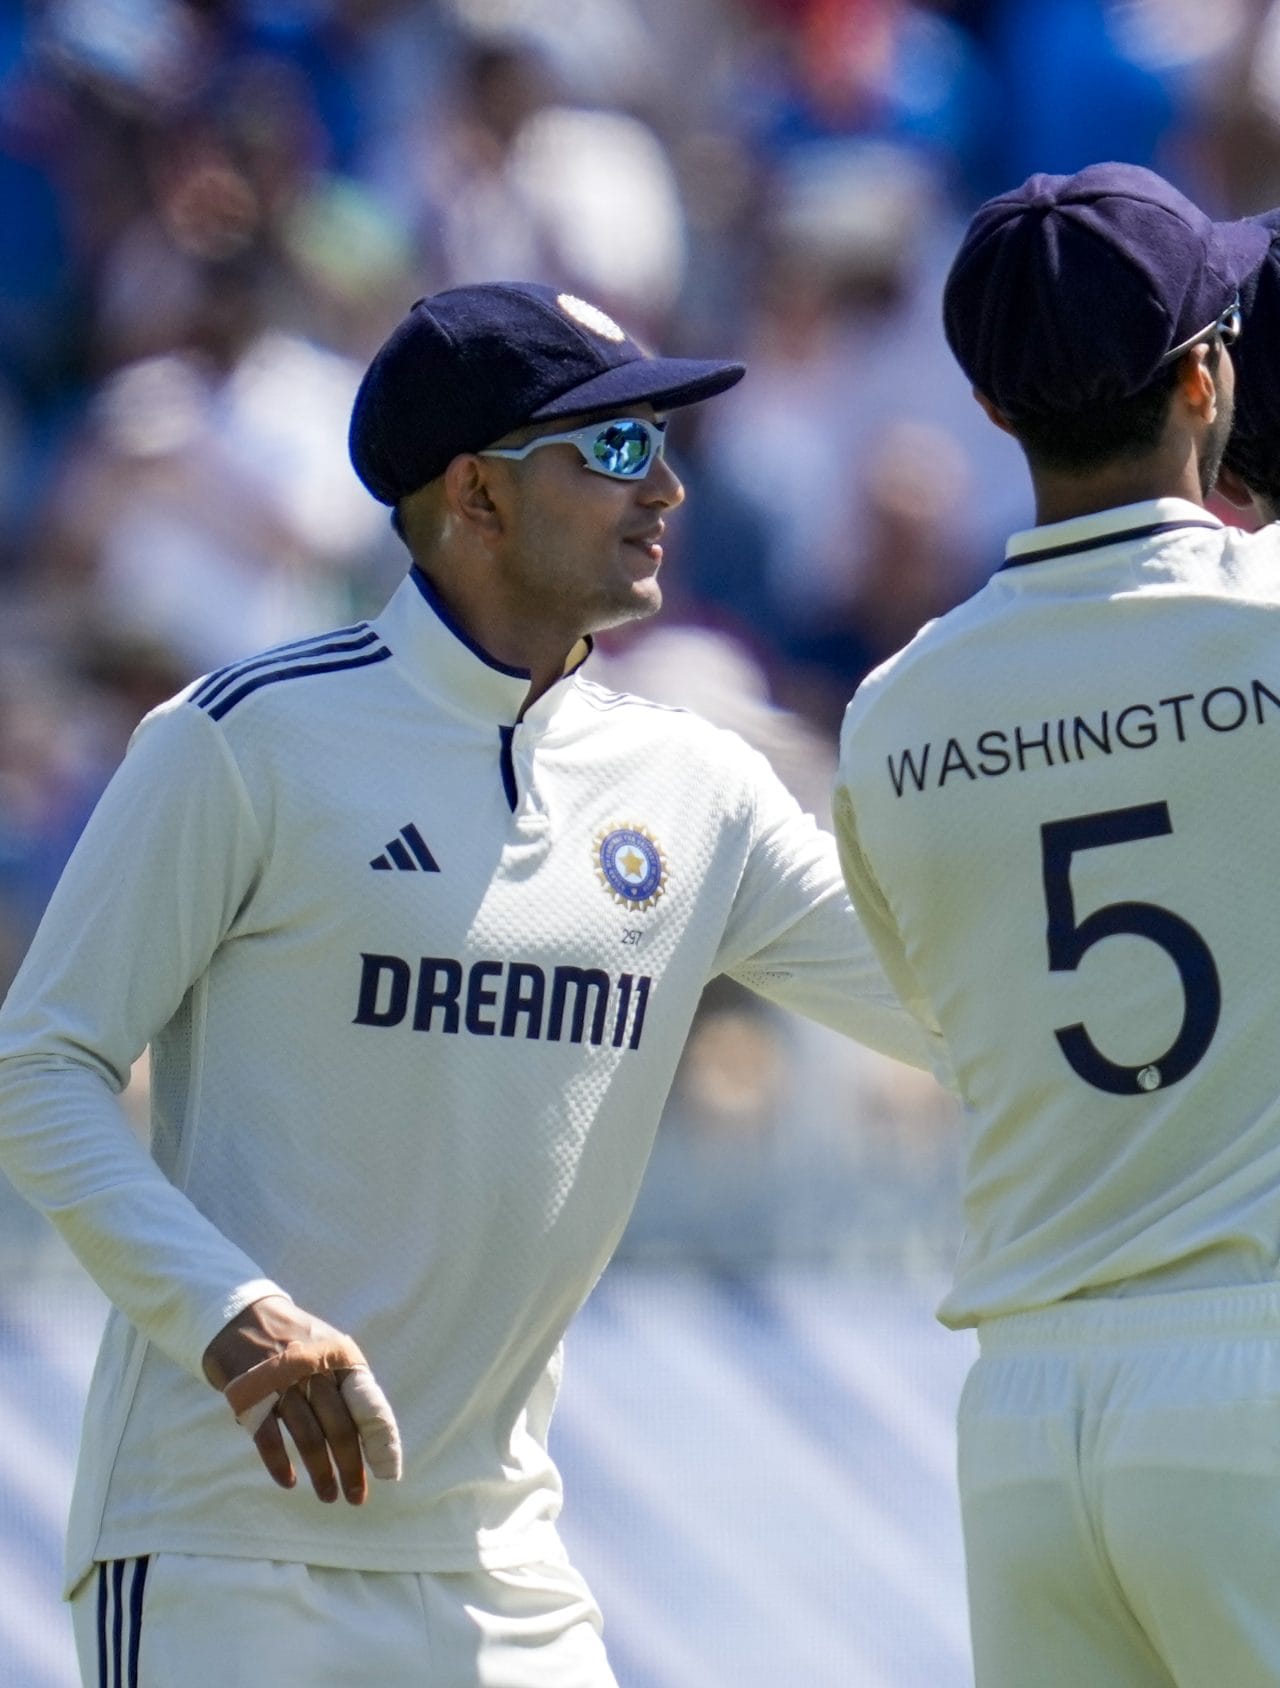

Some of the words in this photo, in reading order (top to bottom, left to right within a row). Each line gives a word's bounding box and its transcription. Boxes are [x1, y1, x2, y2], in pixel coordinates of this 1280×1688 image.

[620, 927, 643, 945] 297
[1040, 801, 1221, 1096] 5
[352, 952, 652, 1051] DREAM11
